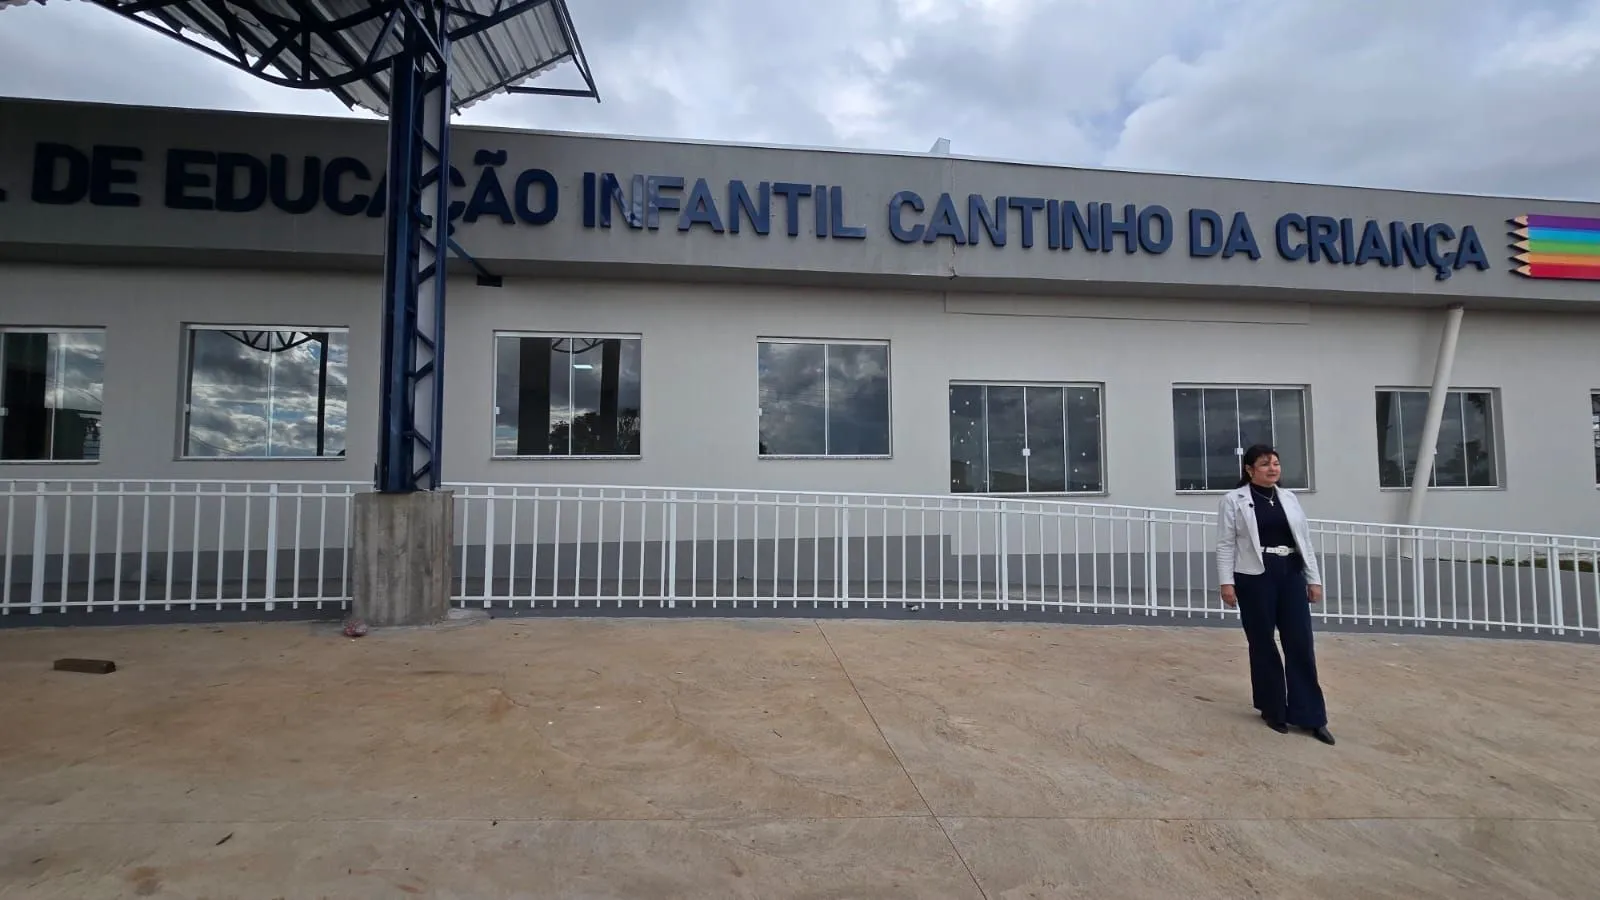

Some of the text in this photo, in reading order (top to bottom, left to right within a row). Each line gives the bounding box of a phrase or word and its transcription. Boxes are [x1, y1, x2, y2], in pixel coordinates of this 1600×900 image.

[31, 141, 1490, 281] DE EDUCÇÃO INFANTIL CANTINHO DA CRIANÇA
